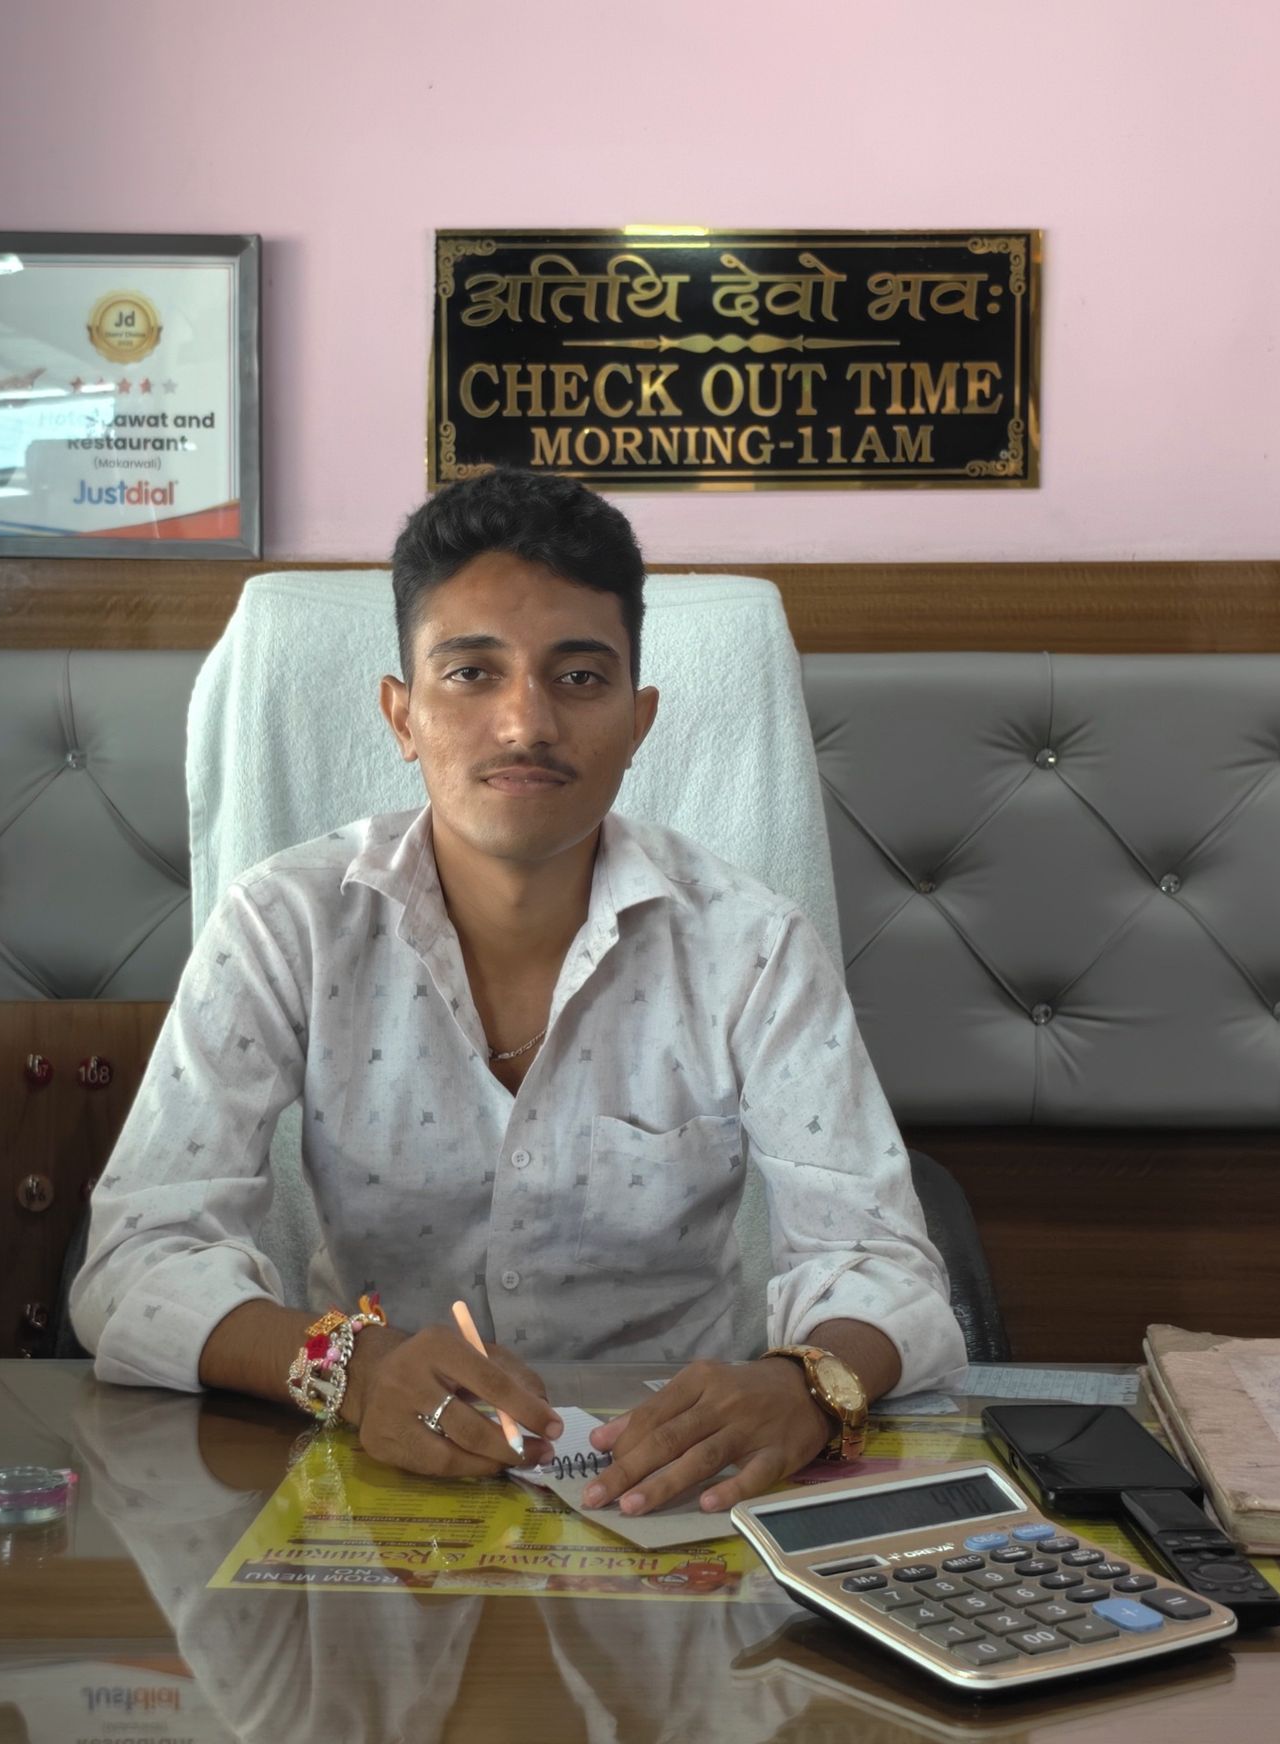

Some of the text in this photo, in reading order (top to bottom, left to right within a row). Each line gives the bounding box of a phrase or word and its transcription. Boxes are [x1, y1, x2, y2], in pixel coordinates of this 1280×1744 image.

[460, 254, 690, 327] अतिथि
[712, 253, 847, 325] देवो
[114, 310, 135, 328] Jd
[460, 362, 1003, 418] CHECK OUT TIME
[102, 412, 168, 428] awat
[173, 412, 215, 428] and
[67, 435, 188, 451] Restaurant
[530, 425, 935, 466] MORNING-11AM
[73, 480, 174, 505] Justdial
[78, 1065, 110, 1084] 108
[477, 1553, 571, 1569] Rawat
[581, 1555, 660, 1571] Hotel
[946, 1555, 982, 1568] MRC
[243, 1571, 399, 1585] ROOM MENU
[936, 1581, 955, 1592] 8
[985, 1571, 1004, 1583] 9
[967, 1597, 987, 1608] 5
[1016, 1587, 1035, 1599] 6
[997, 1615, 1018, 1627] 2
[1047, 1604, 1068, 1616] 3
[1022, 1630, 1056, 1645] 00
